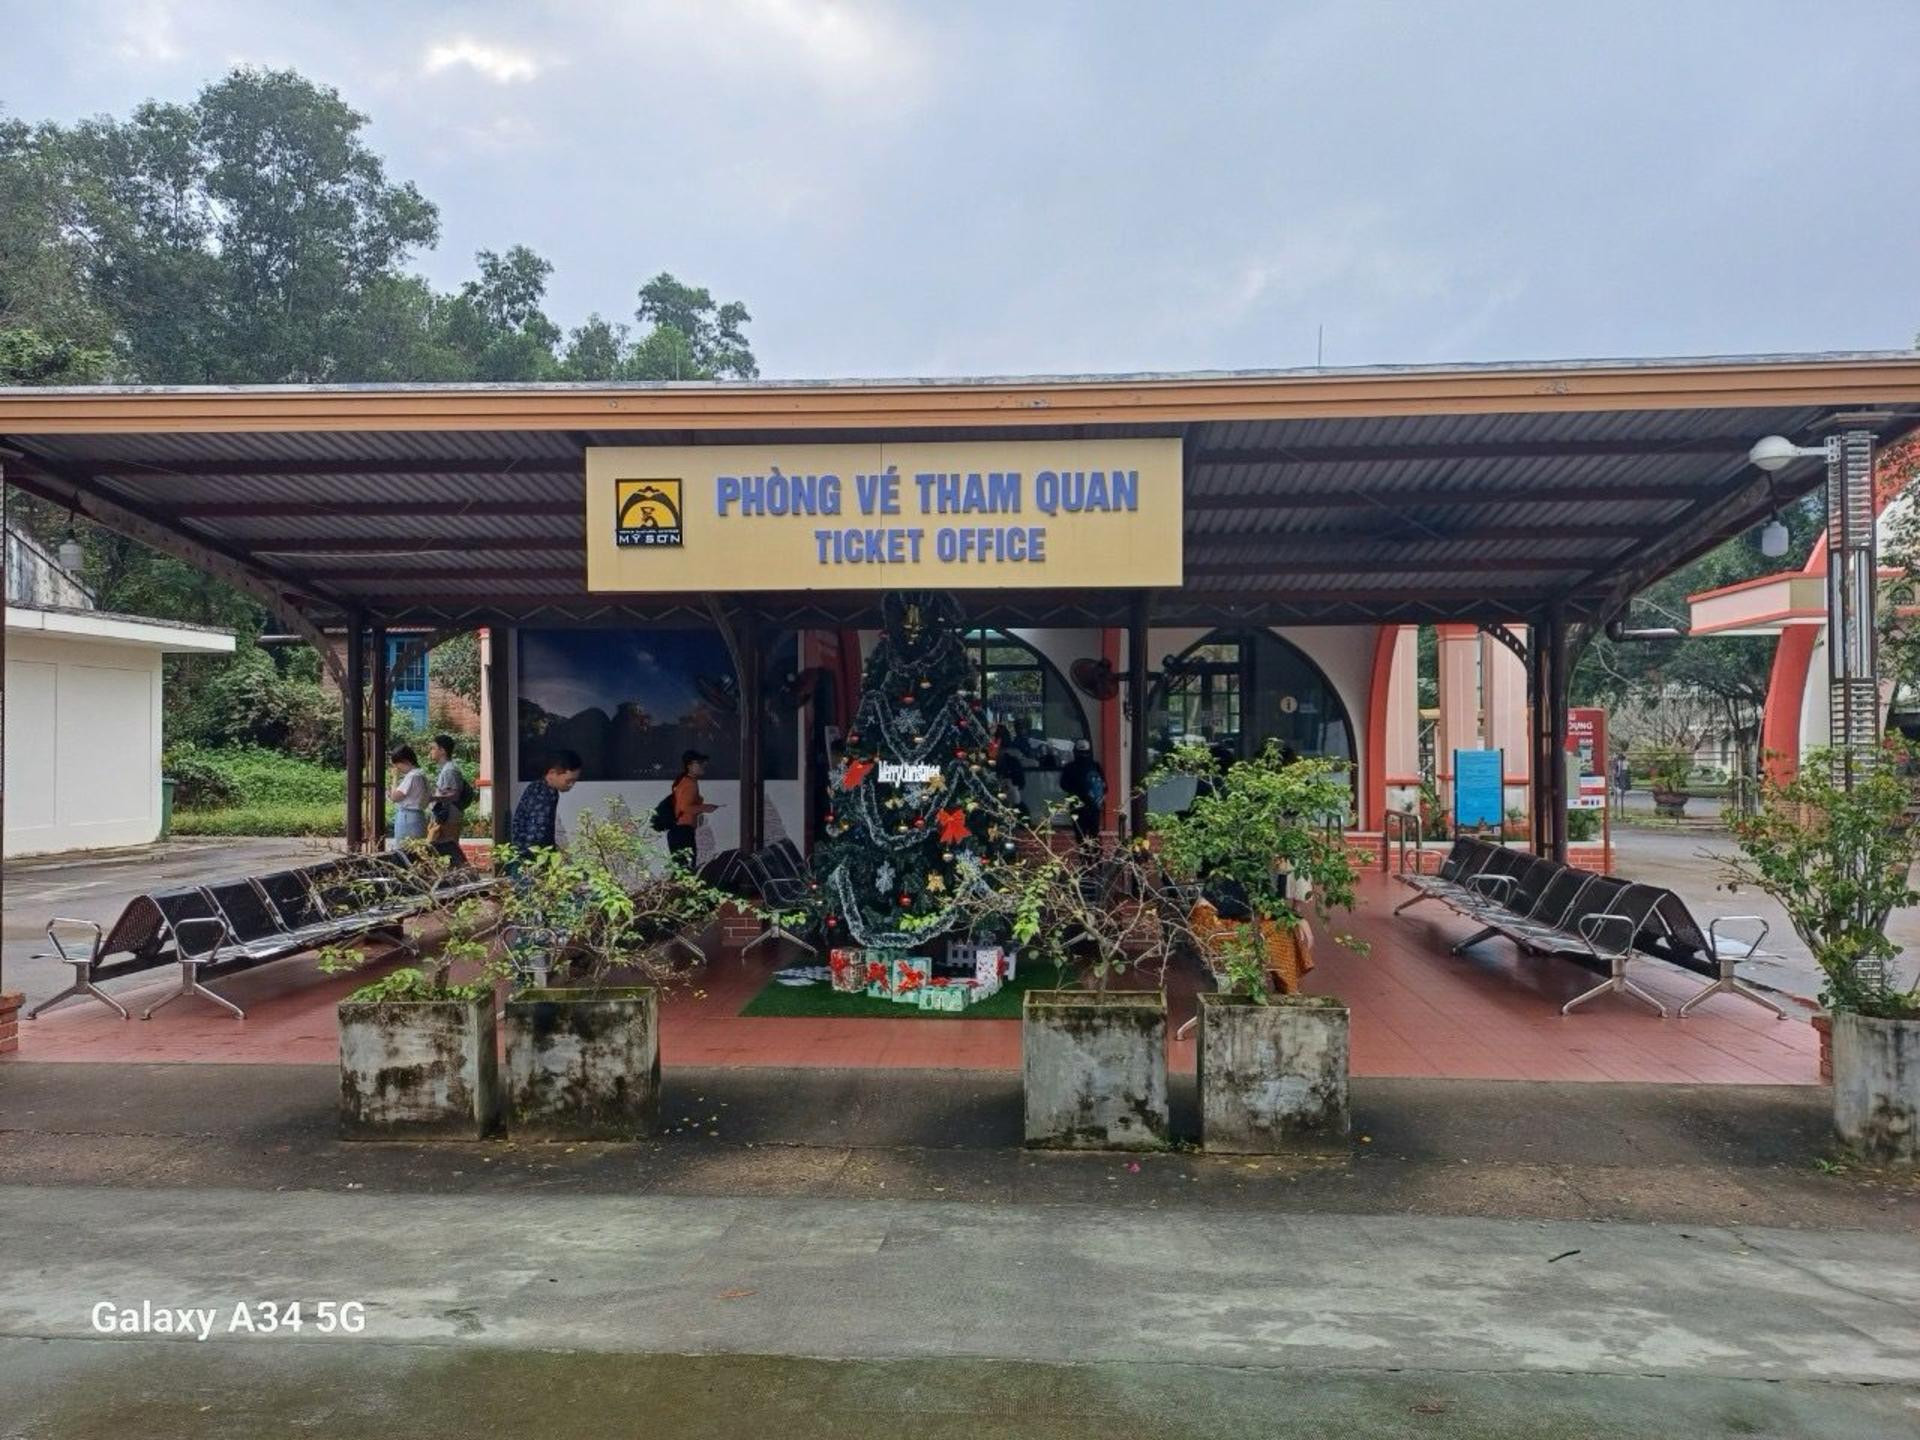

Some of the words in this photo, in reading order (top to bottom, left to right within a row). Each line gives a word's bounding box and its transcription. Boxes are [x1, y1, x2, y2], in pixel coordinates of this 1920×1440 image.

[716, 465, 841, 517] PHÒNG
[856, 465, 900, 515] VÉ
[915, 472, 1021, 515] THAM
[1036, 470, 1139, 517] QUAN
[814, 528, 925, 565] TICKET
[936, 526, 1047, 563] OFFICE
